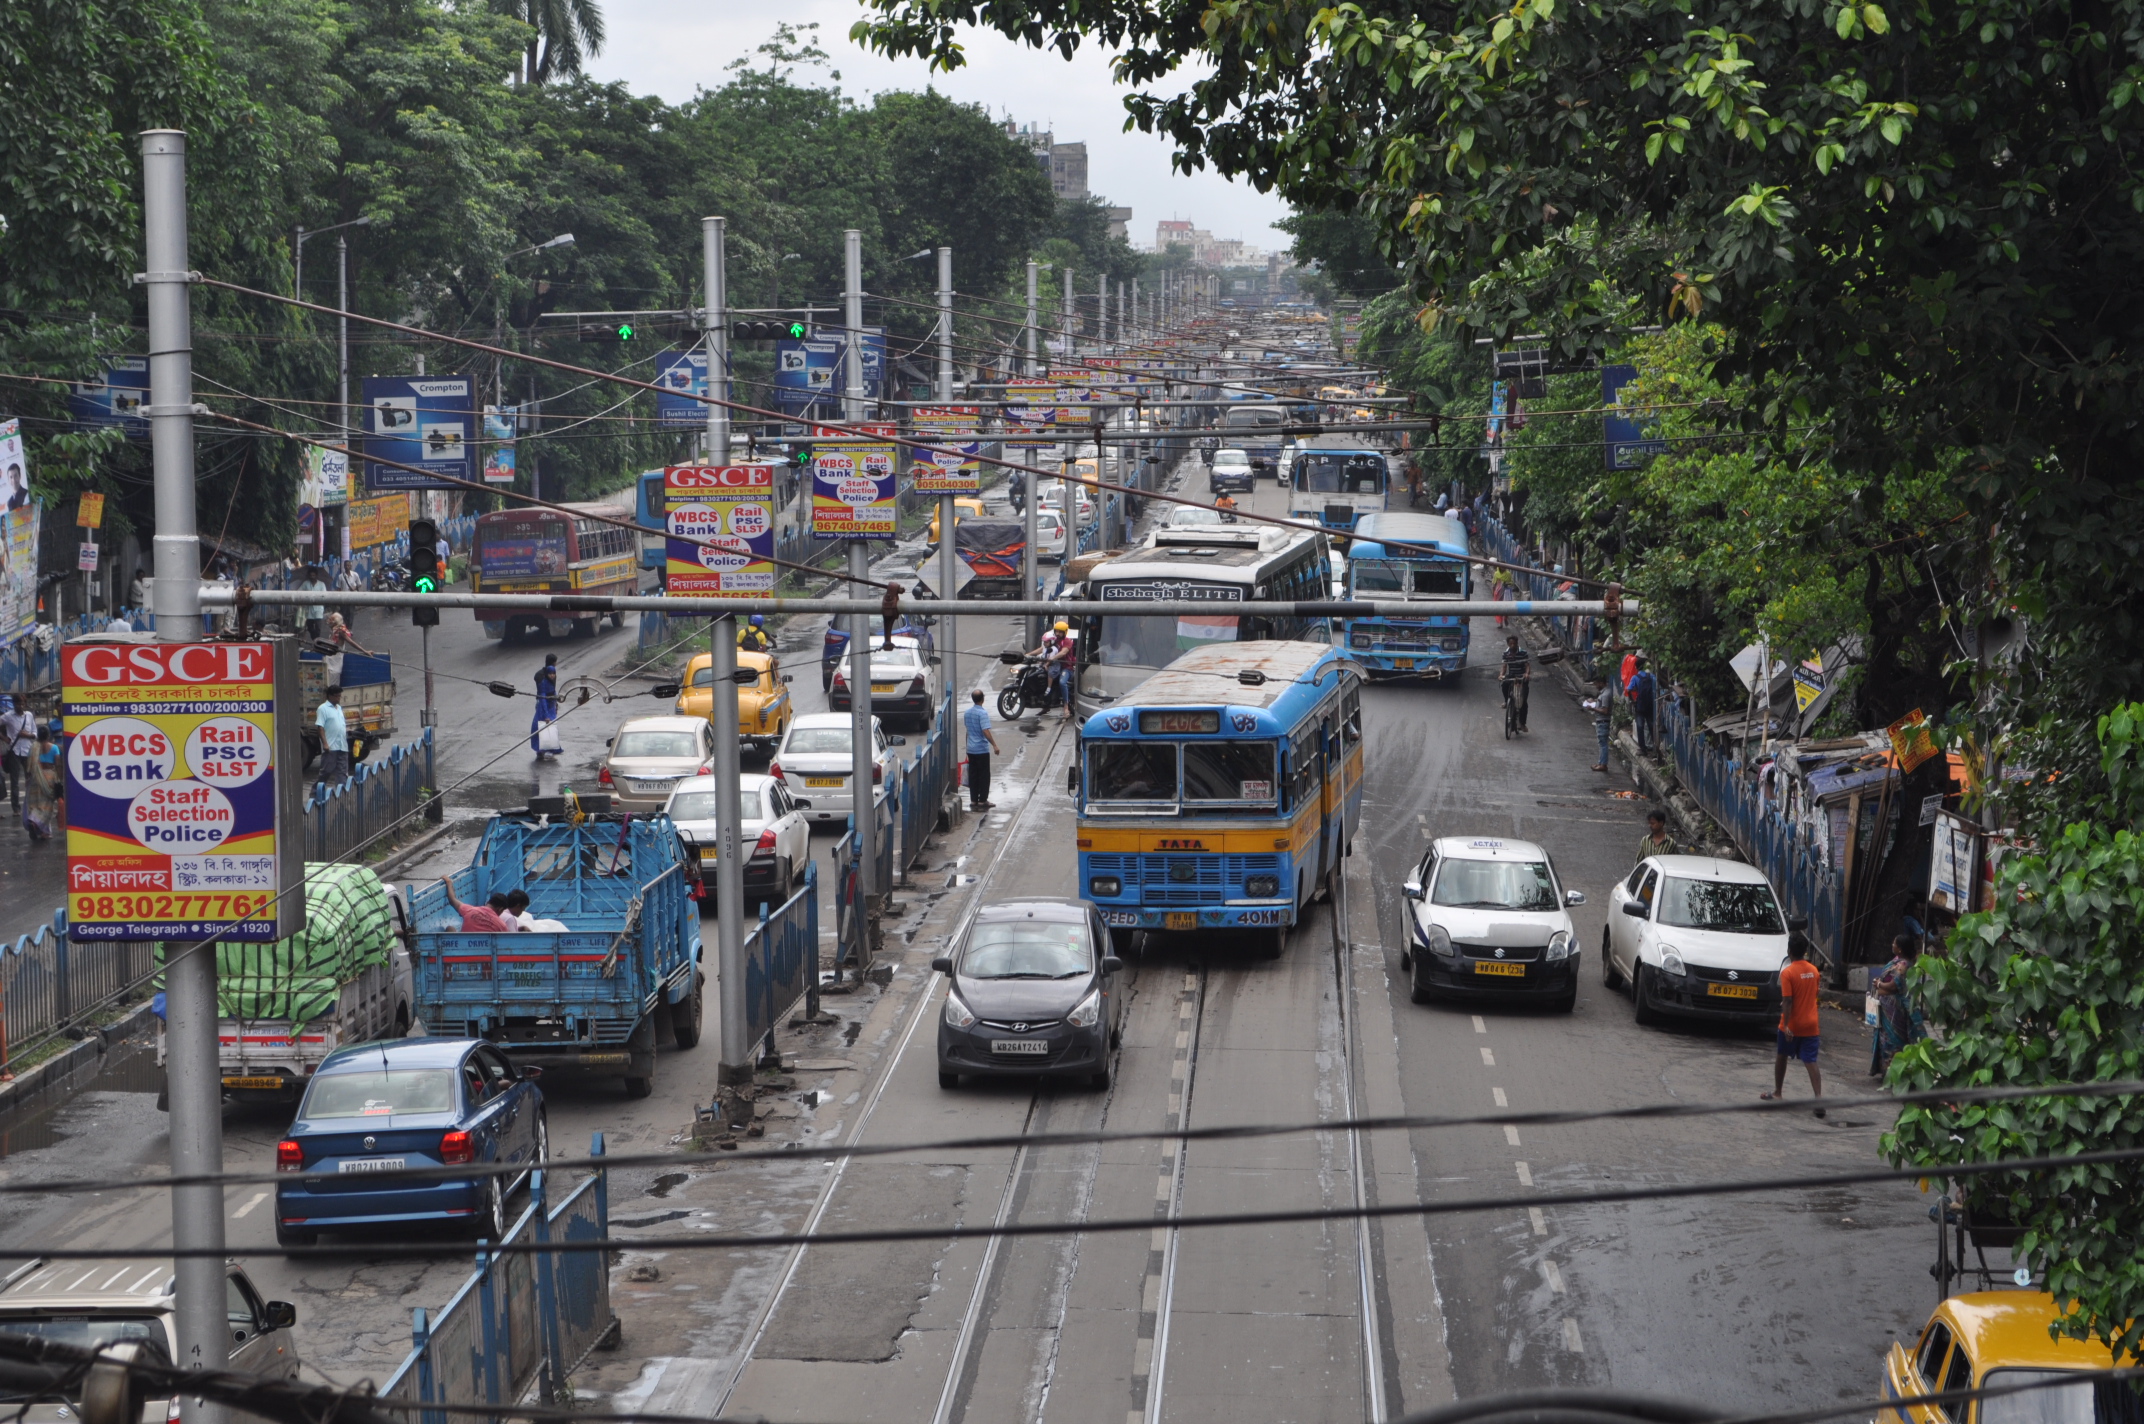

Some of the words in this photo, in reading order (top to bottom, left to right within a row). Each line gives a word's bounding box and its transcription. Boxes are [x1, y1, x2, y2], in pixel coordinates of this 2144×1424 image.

[420, 384, 464, 392] Crompton
[819, 459, 853, 468] WBCS
[669, 467, 769, 487] GSCE
[820, 469, 852, 477] Bank
[917, 480, 976, 489] 9051040306
[674, 511, 718, 523] WBCS
[734, 507, 762, 516] Rail
[735, 517, 763, 525] PSC
[816, 522, 891, 531] 9674087465
[674, 524, 717, 535] Bank
[735, 525, 764, 533] SLST
[709, 539, 740, 547] Staff
[701, 547, 750, 556] Selecn
[706, 557, 746, 566] Police
[668, 577, 719, 590] শিয়ালদহ
[1106, 587, 1174, 600] Shohagh
[1180, 589, 1238, 600] ELITE
[71, 645, 266, 684] GSCE
[83, 687, 142, 701] পড়লেই
[146, 686, 203, 699] সরকারি
[209, 685, 252, 698] চাকরি
[71, 704, 121, 715] Helpline
[130, 702, 267, 714] 9830277100/200/300
[200, 726, 254, 743] Rail
[80, 733, 166, 757] WBCS
[202, 746, 256, 760] PSC
[81, 760, 165, 781] Bank
[201, 761, 258, 778] SLST
[150, 788, 210, 804] Staff
[135, 805, 230, 822] Selection
[144, 825, 223, 843] Police
[1160, 839, 1203, 849] TATA
[97, 858, 114, 868] হেড
[116, 857, 142, 867] অফিস
[174, 862, 198, 871] ১৩৬
[240, 858, 273, 874] গাঙ্গুলি
[70, 864, 169, 890] শিয়ালদহ
[203, 874, 269, 886] কলকাতা-১২
[76, 894, 269, 920] 9830277761
[78, 924, 124, 936] George
[126, 924, 187, 936] Telegraph
[204, 923, 238, 934] Since
[242, 923, 271, 933] 1920
[441, 940, 459, 948] SAFE
[468, 939, 489, 948] DRIVE
[561, 938, 582, 947] SAVE
[589, 938, 606, 947] LIFE
[512, 962, 536, 970] OBEY
[559, 961, 606, 981] HOR
[508, 971, 542, 980] TRAFFIC
[1723, 987, 1732, 995] 07
